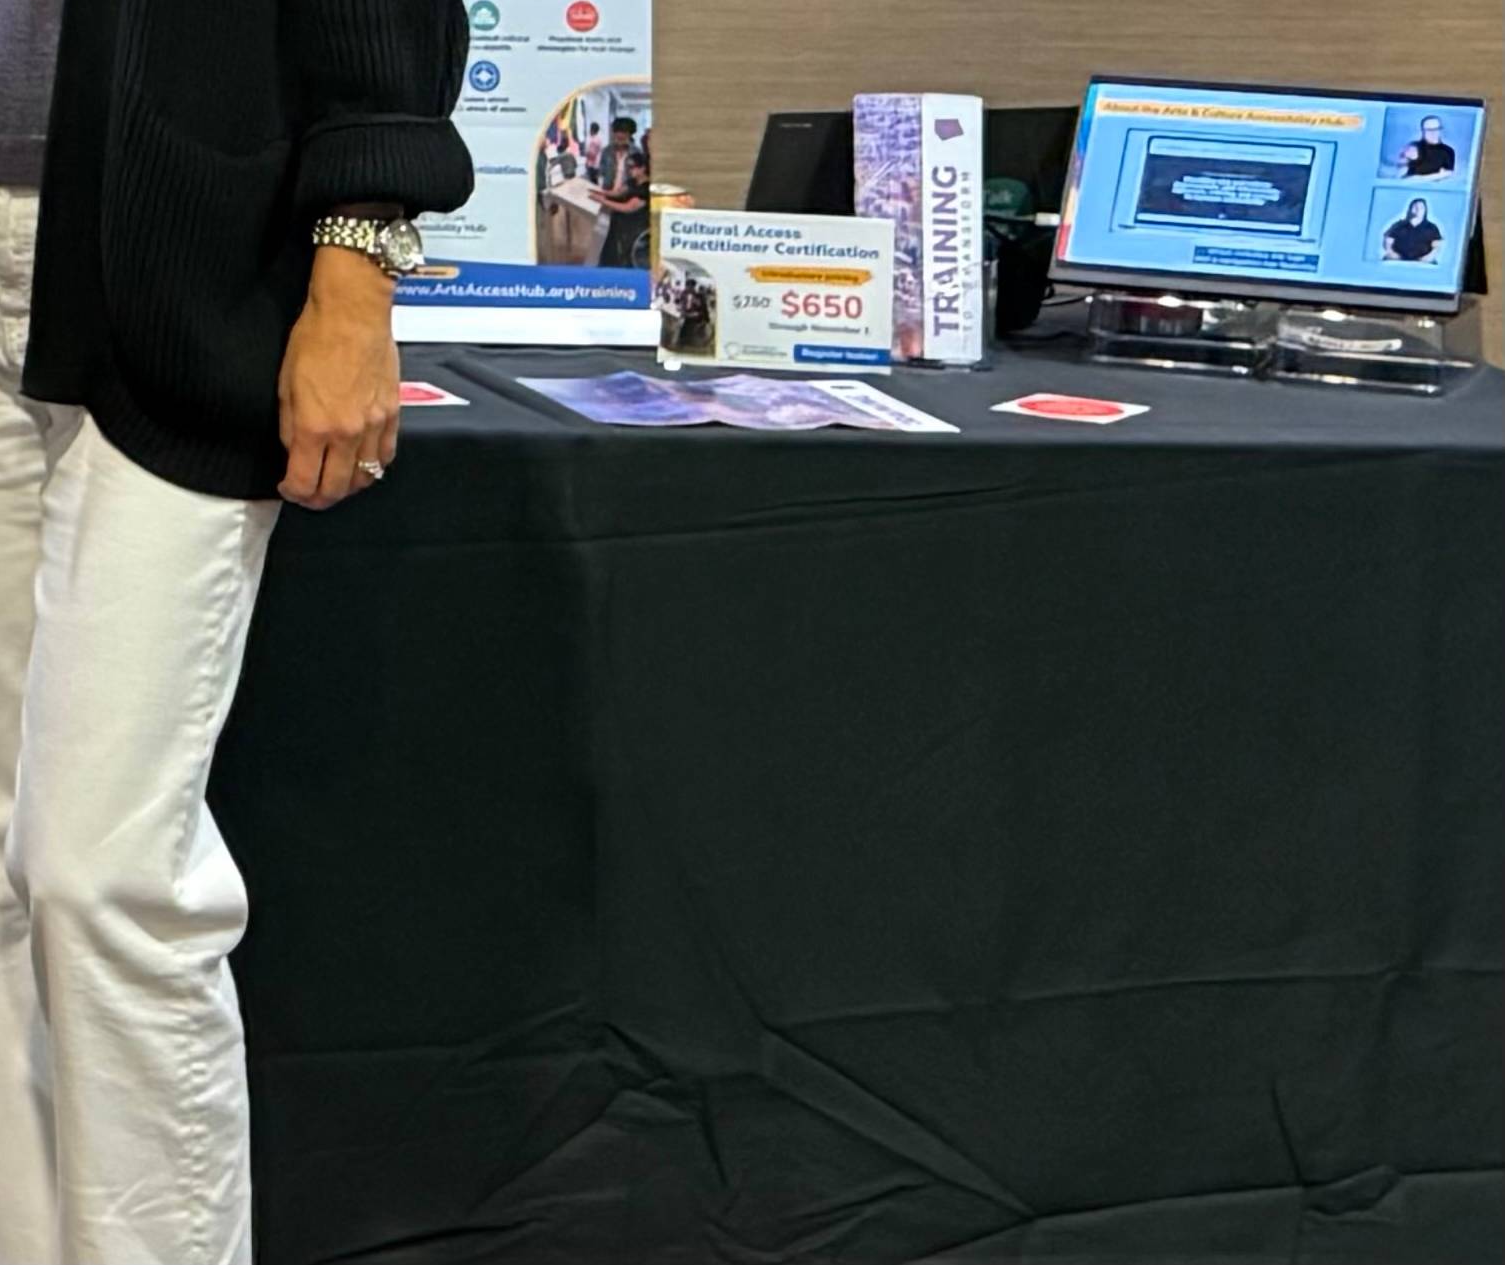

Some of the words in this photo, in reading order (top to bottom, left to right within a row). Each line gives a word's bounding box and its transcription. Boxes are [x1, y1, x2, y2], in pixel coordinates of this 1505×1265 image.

[670, 220, 739, 236] Cultural
[743, 224, 802, 240] Access
[670, 236, 769, 254] Practitioner
[774, 242, 880, 259] Certification
[932, 166, 960, 336] TRAINING
[781, 290, 863, 319] $650
